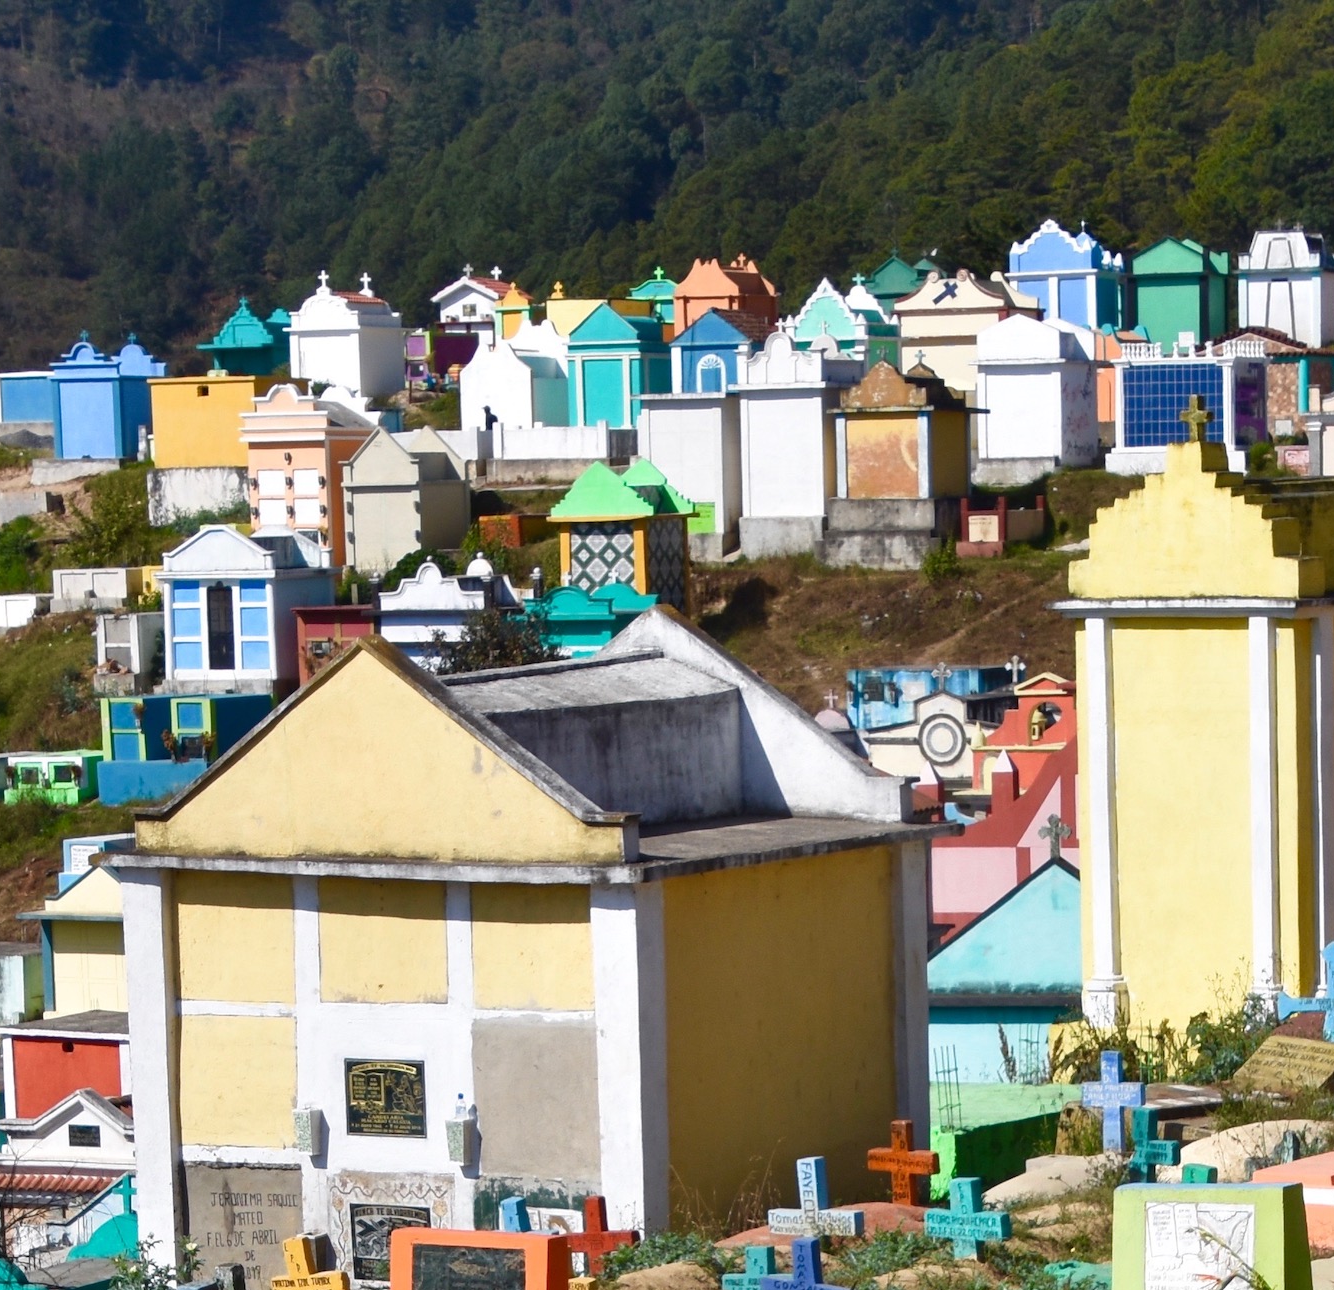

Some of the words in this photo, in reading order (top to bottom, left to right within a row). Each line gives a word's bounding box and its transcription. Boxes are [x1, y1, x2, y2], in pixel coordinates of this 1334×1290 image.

[211, 1192, 262, 1207] JERONIMA
[268, 1194, 298, 1207] SAQUIC
[233, 1212, 263, 1226] MATEO
[234, 1231, 245, 1247] DE
[252, 1230, 279, 1245] ABRIL
[245, 1250, 255, 1261] DE
